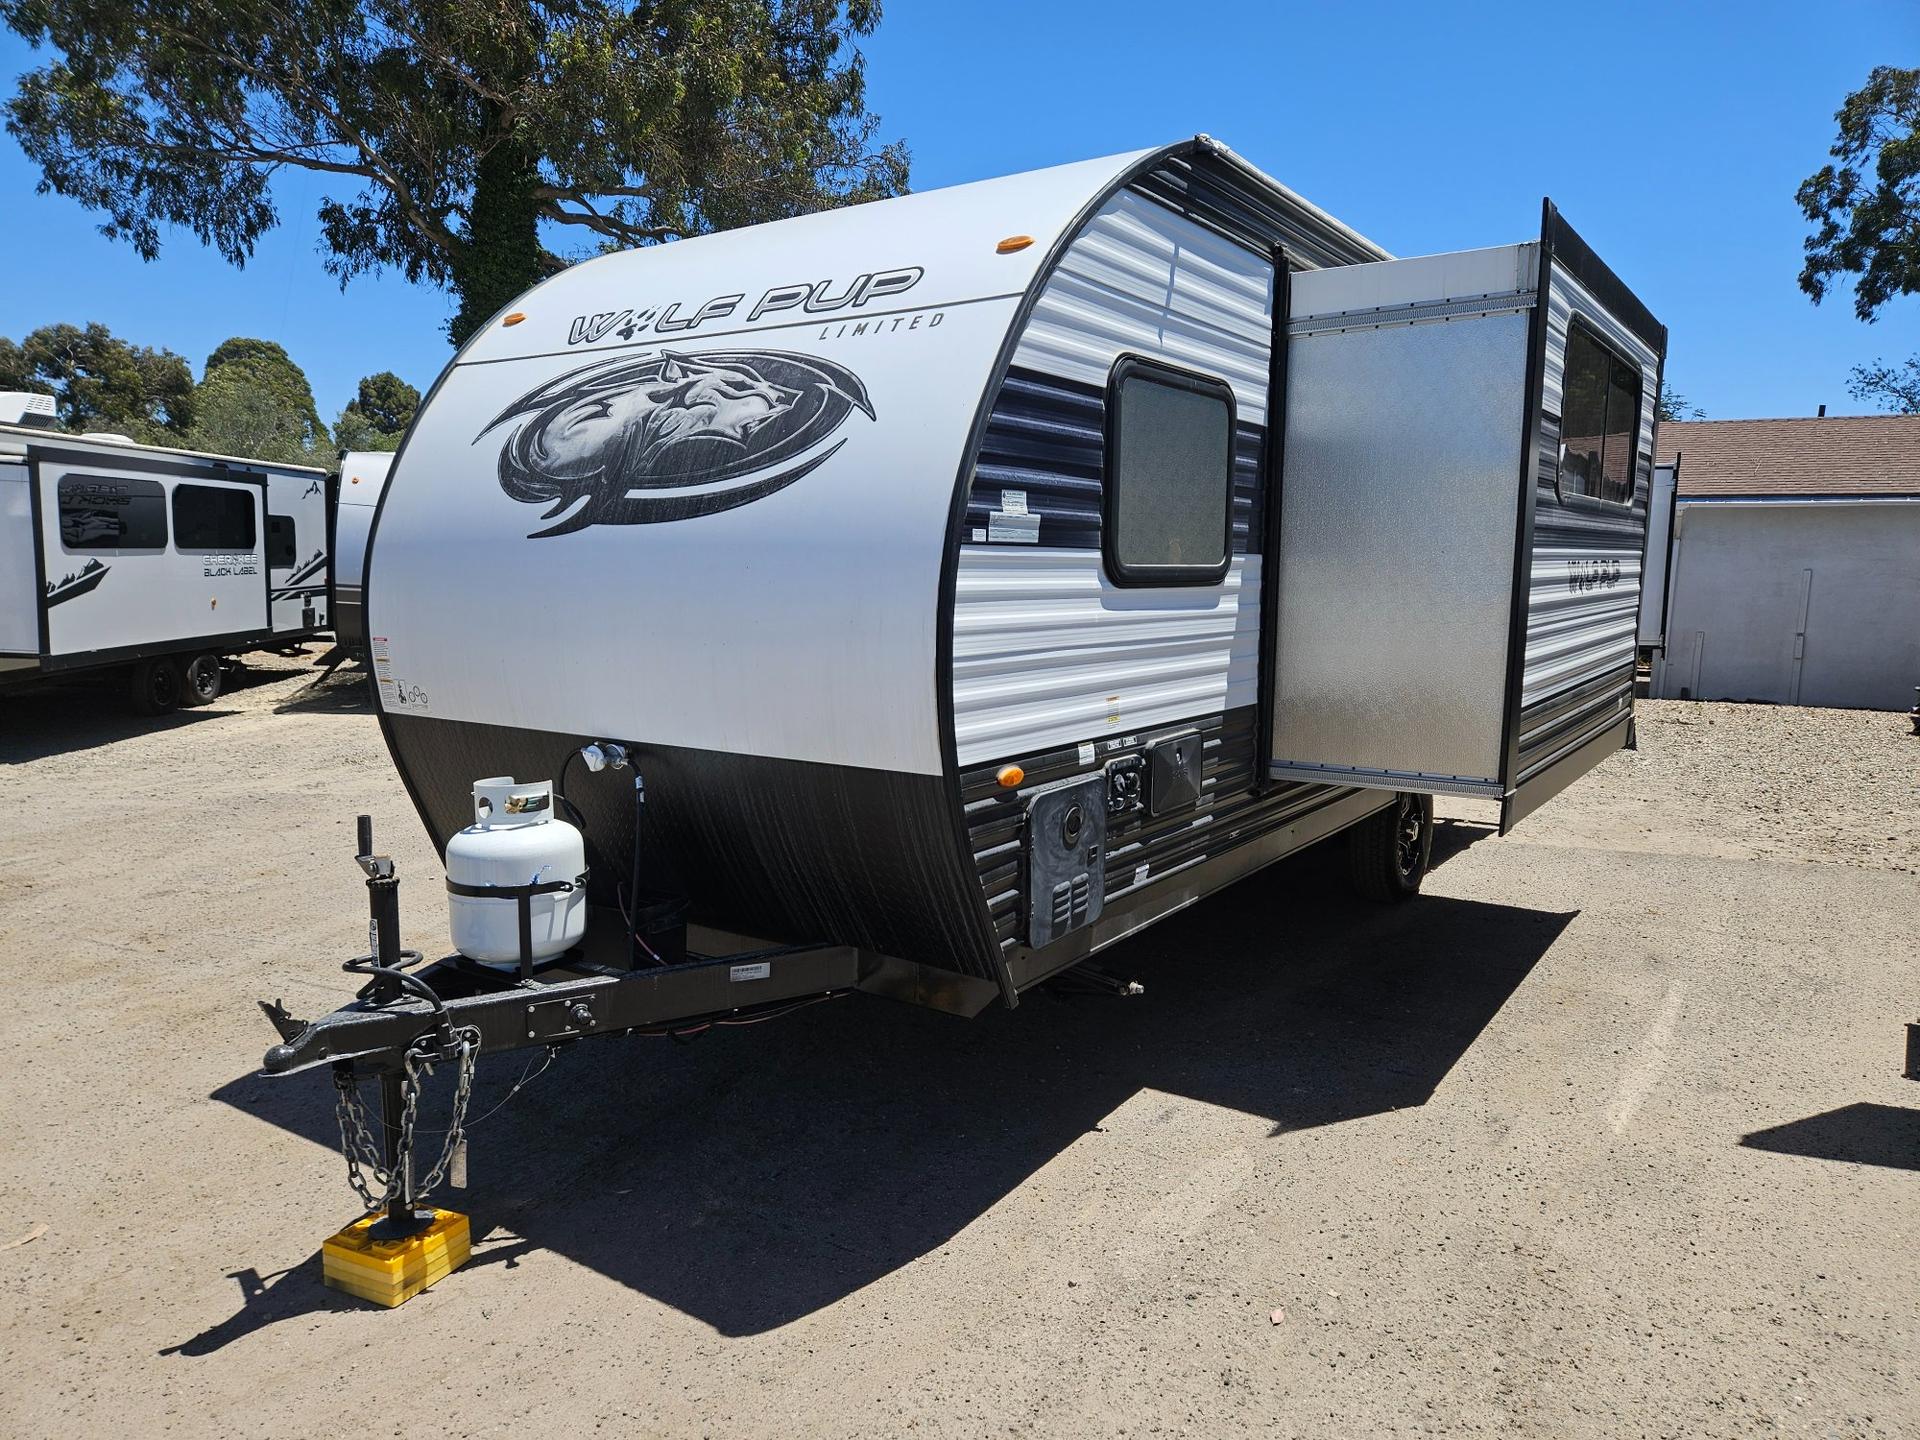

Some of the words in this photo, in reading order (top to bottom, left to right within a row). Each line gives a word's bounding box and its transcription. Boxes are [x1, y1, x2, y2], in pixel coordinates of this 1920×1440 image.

[746, 266, 925, 322] PUP
[818, 312, 945, 341] LIMITED
[204, 567, 231, 577] BLACK
[233, 566, 258, 576] LABEL
